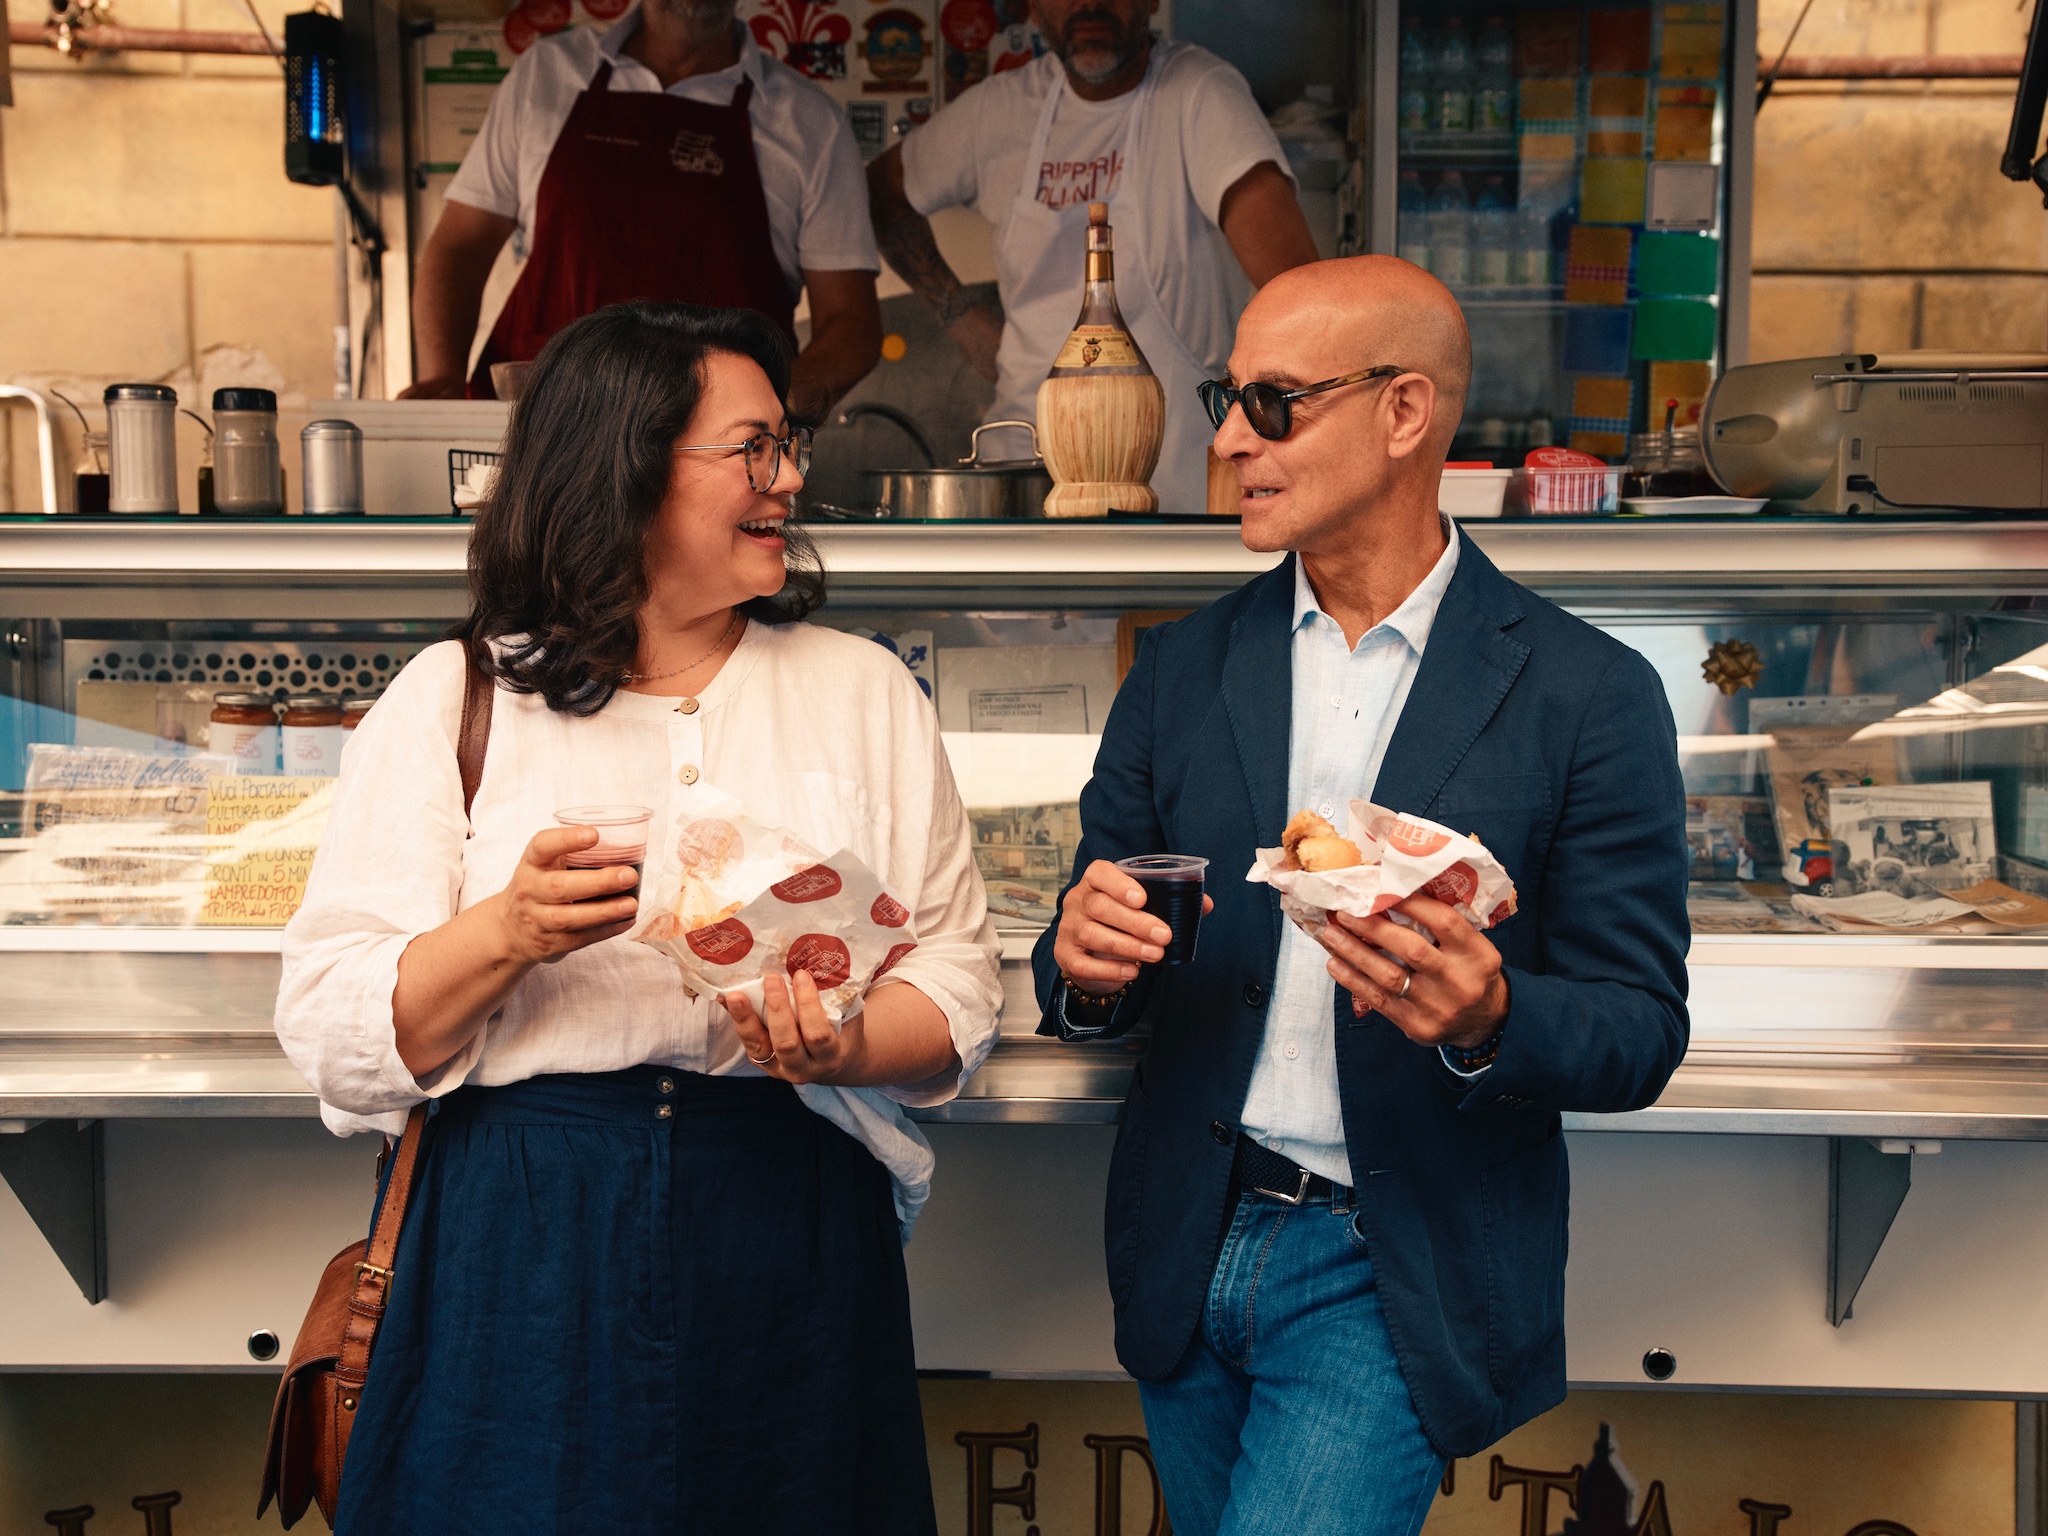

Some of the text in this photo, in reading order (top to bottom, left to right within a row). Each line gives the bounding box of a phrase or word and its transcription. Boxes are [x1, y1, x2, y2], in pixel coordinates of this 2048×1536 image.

[207, 804, 261, 821] CULTURA
[206, 863, 253, 883] RONTI
[273, 863, 286, 884] 5
[209, 883, 298, 902] LAMPREDOTTO
[203, 901, 248, 919] TRIPPA
